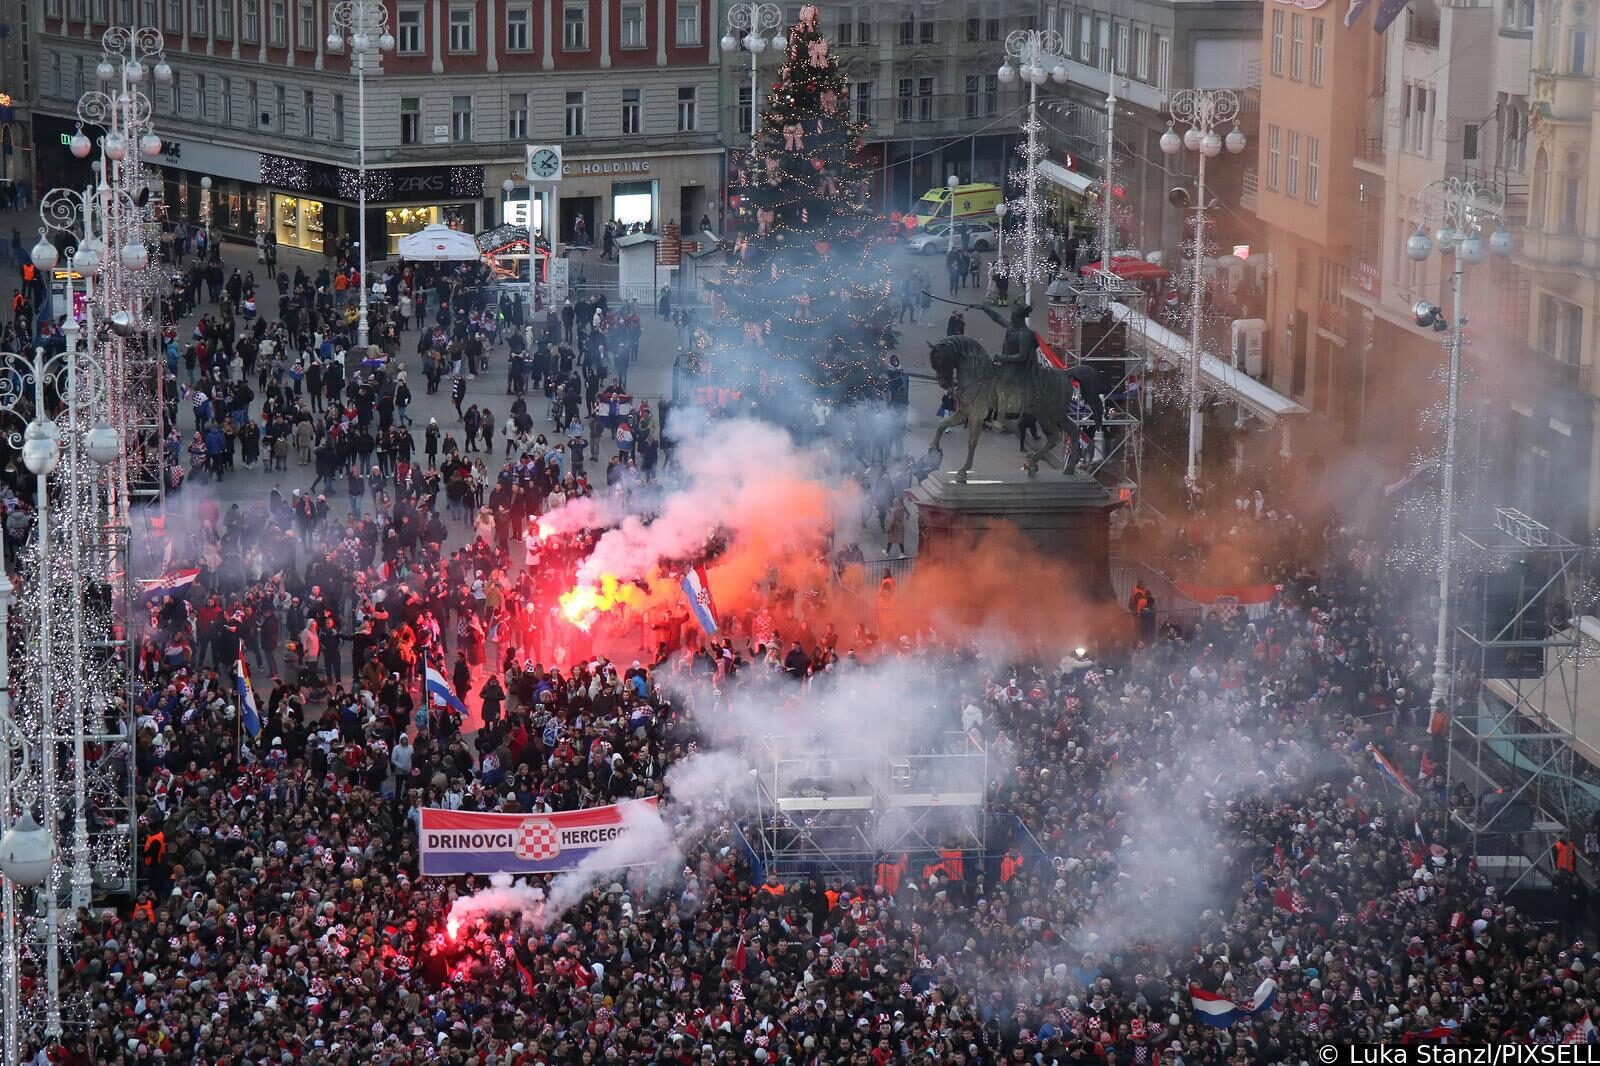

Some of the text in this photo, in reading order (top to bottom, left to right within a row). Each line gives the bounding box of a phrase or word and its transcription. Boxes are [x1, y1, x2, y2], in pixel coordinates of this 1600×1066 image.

[583, 161, 650, 174] HOLDING
[398, 176, 444, 191] ZAKS
[428, 826, 631, 849] DRINOVCI HERCEGO
